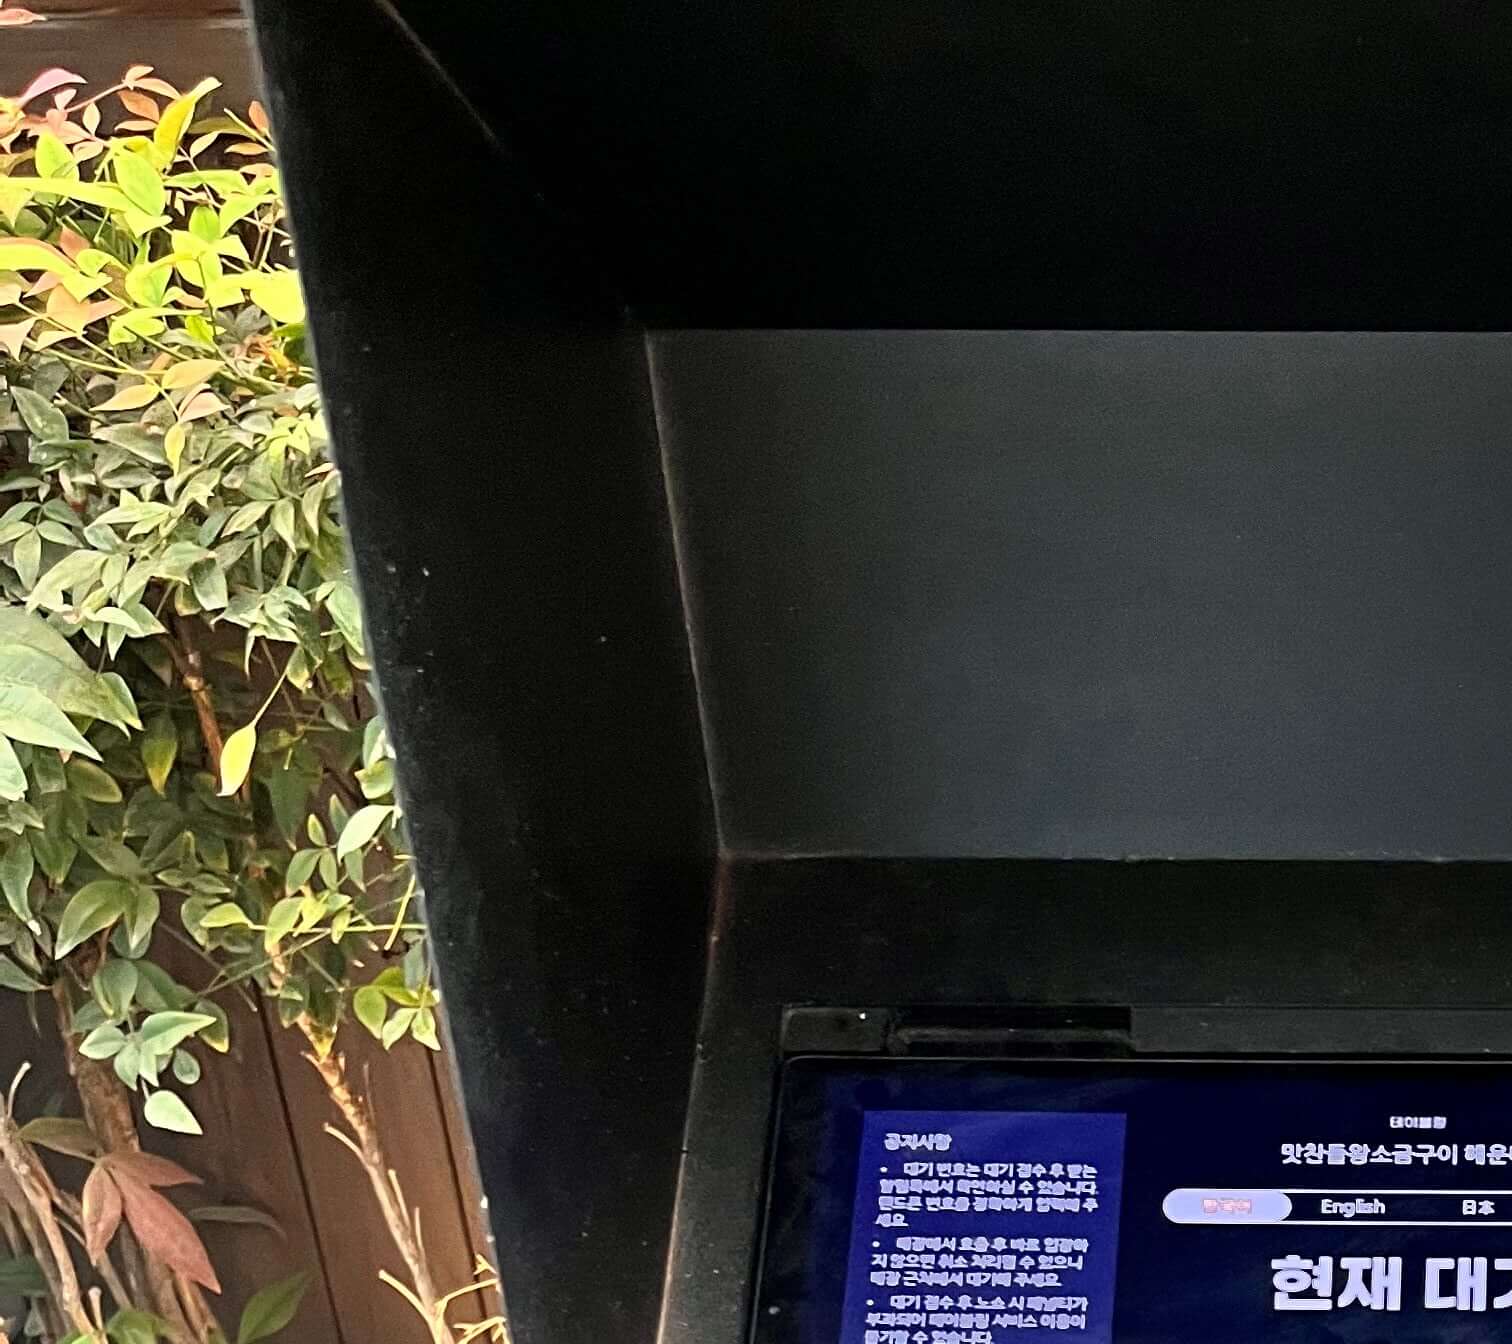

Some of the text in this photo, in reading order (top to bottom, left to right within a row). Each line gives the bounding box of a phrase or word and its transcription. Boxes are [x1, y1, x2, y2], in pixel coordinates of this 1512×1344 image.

[1388, 1115, 1447, 1130] 테이블링
[884, 1132, 952, 1151] 공지사항
[1280, 1142, 1459, 1167] 맛찬들왕소금구이
[903, 1162, 934, 1177] 대기
[936, 1162, 981, 1178] 번호는
[983, 1162, 1014, 1178] 대기
[1049, 1162, 1065, 1178] 후
[1018, 1180, 1034, 1194] 수
[1200, 1196, 1254, 1216] 한국어
[1320, 1197, 1386, 1218] English
[1461, 1198, 1496, 1216] 日本
[992, 1237, 1007, 1252] 후
[871, 1254, 887, 1268] 지
[1018, 1255, 1035, 1270] 수
[1037, 1255, 1083, 1270] 있으니
[1270, 1253, 1403, 1314] 현재
[890, 1295, 921, 1310] 대기
[956, 1295, 974, 1311] 후
[1008, 1296, 1024, 1311] 시
[992, 1313, 1038, 1329] 서비스
[1039, 1313, 1086, 1330] 이용이
